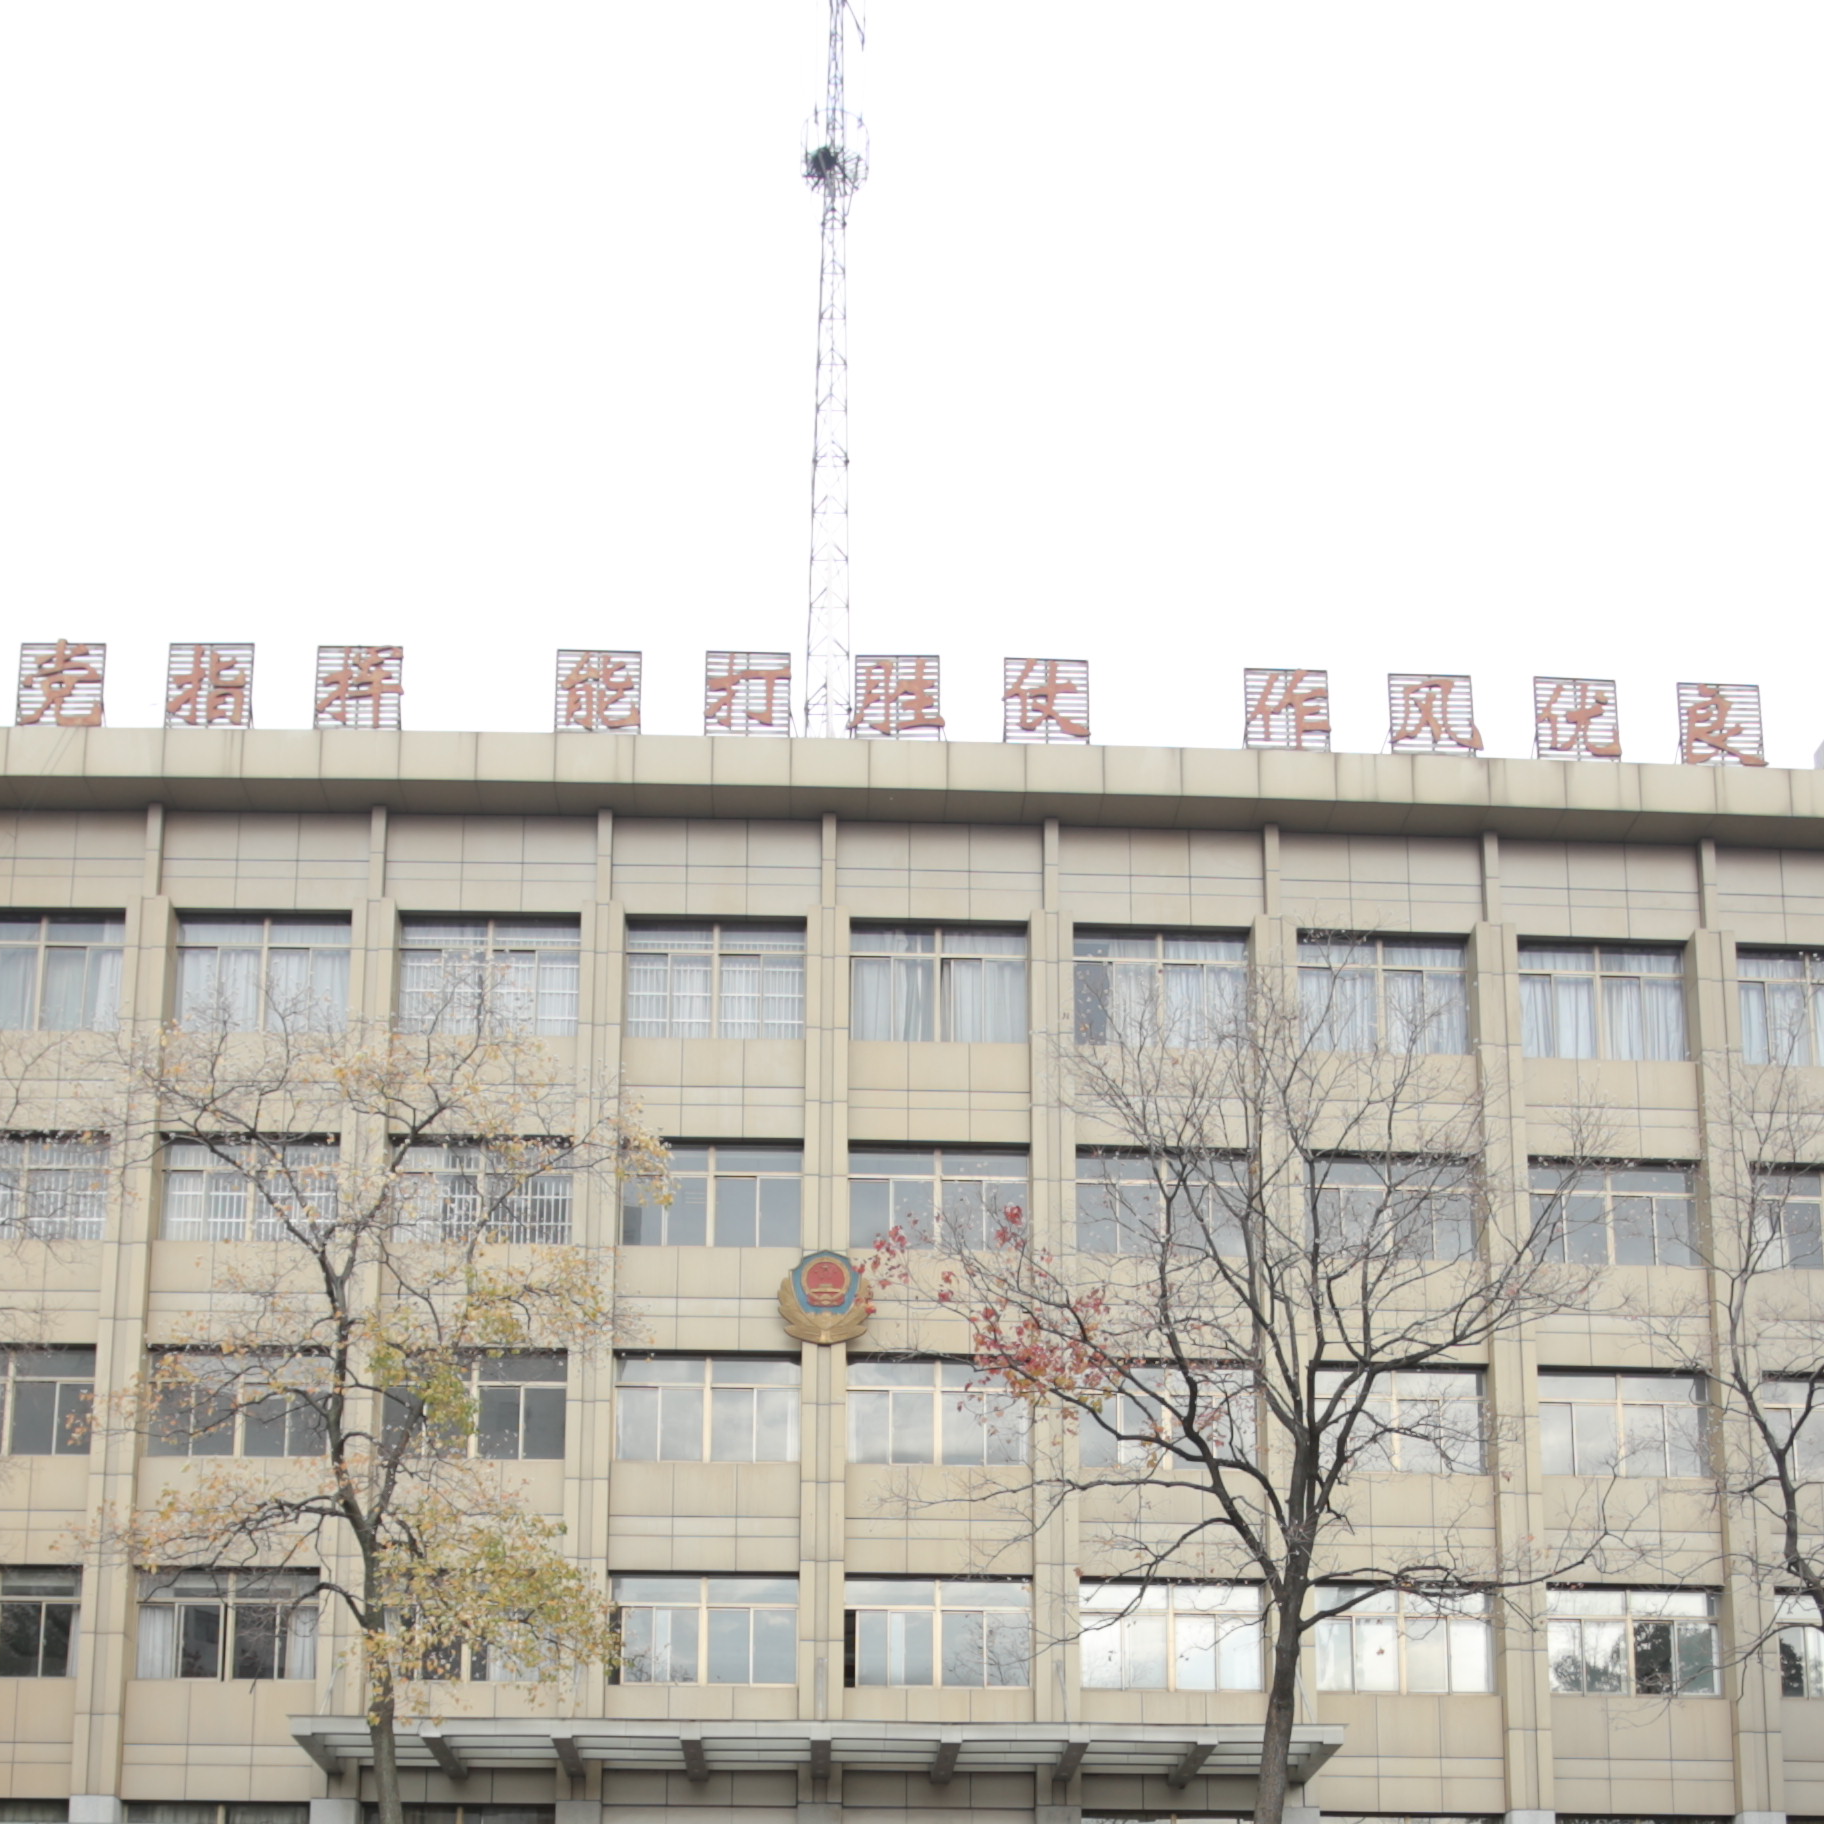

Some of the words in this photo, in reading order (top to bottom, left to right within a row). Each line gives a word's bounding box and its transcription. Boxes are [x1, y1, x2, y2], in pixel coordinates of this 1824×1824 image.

[561, 651, 1091, 737] 能打胜仗
[1246, 669, 1769, 767] 作风优良
